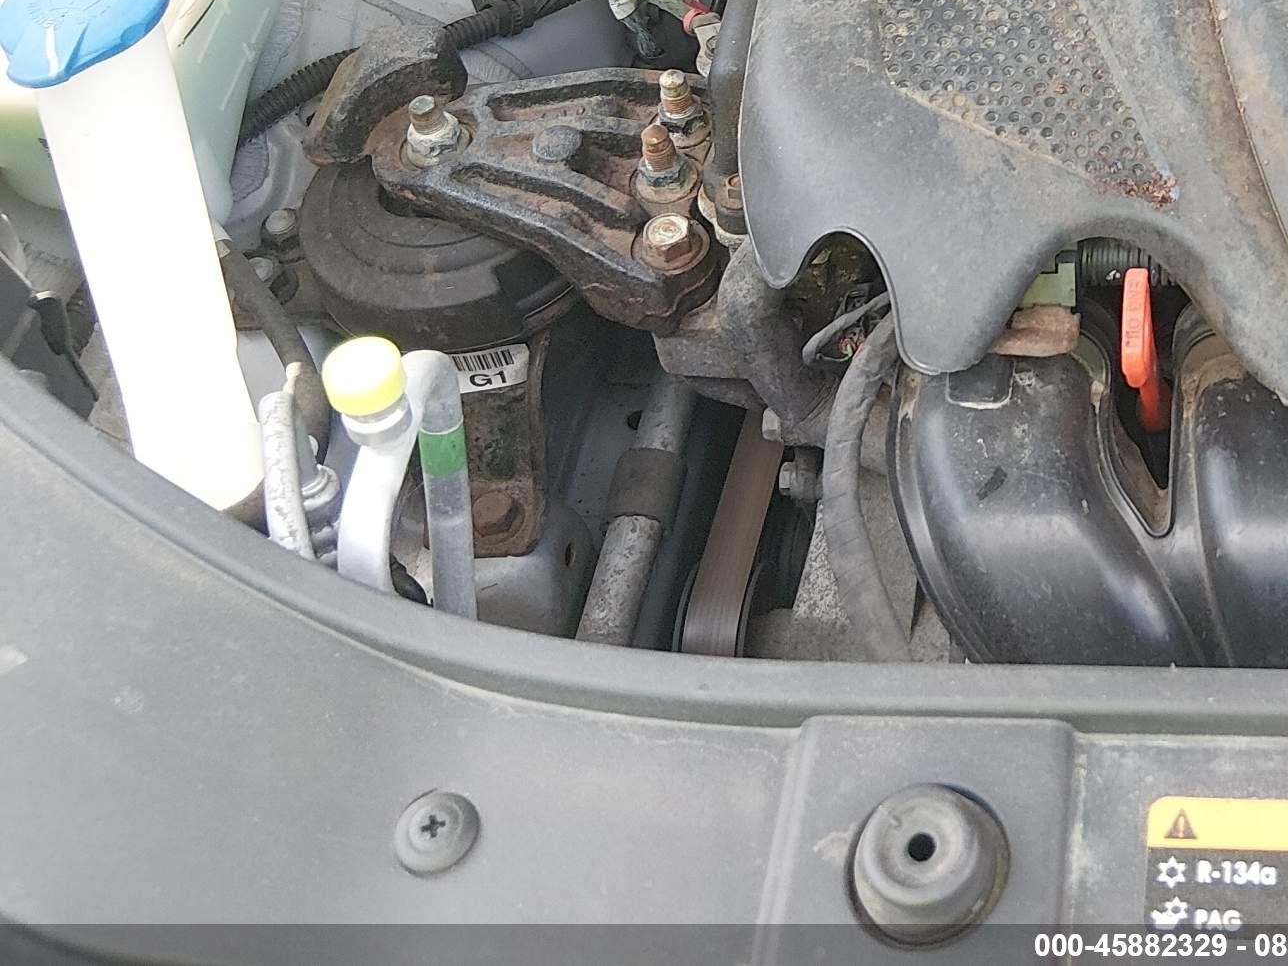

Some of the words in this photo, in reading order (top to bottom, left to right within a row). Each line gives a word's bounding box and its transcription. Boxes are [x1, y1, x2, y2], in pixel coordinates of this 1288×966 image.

[469, 370, 507, 387] G1
[1197, 860, 1277, 885] R-134a
[1194, 909, 1242, 931] PAG
